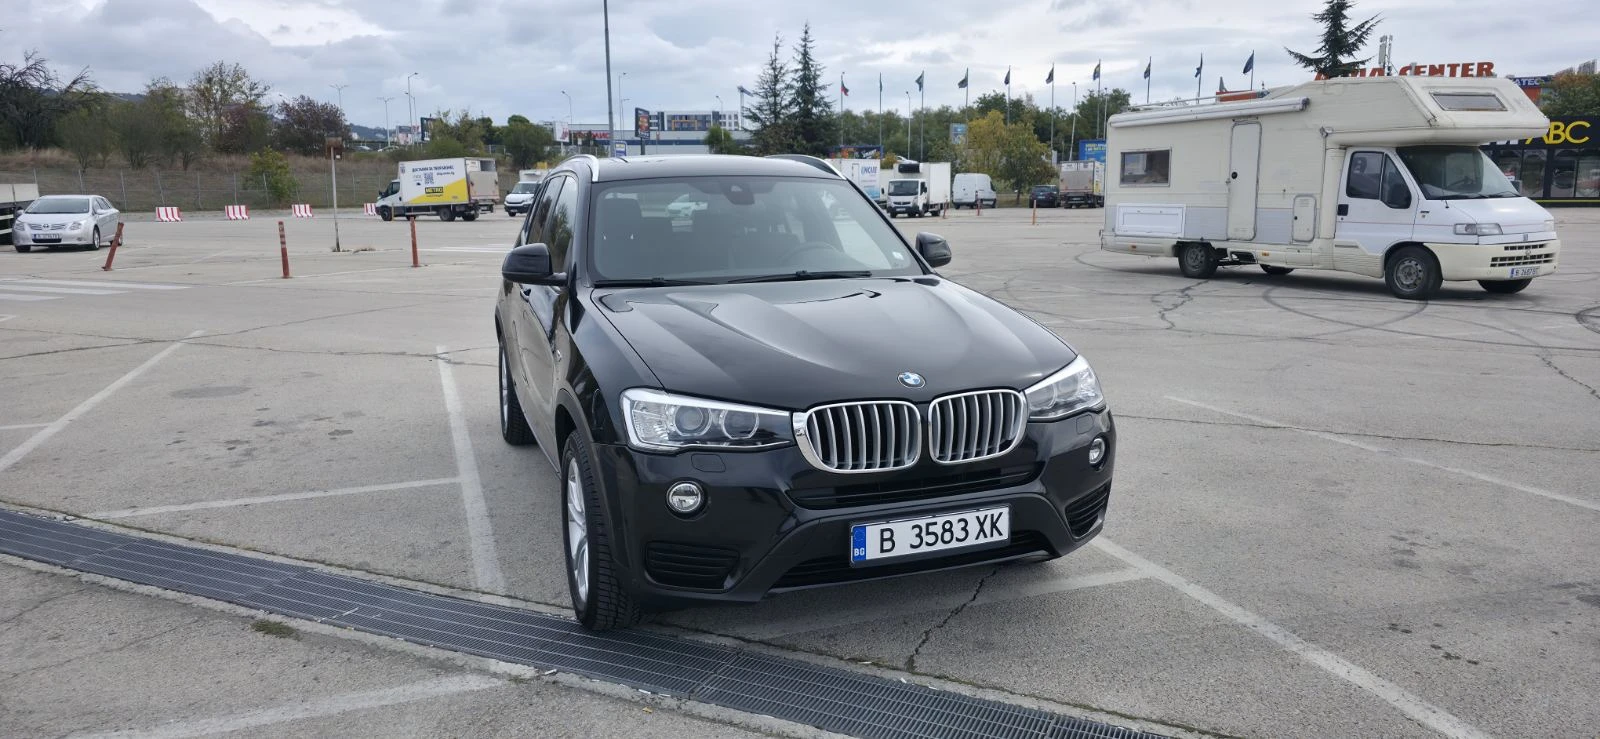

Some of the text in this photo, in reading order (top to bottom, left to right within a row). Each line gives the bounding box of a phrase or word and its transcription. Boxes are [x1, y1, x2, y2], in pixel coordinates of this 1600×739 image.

[1399, 62, 1495, 78] CENTER
[880, 512, 1004, 554] B 3583 XK
[854, 547, 866, 557] BG
